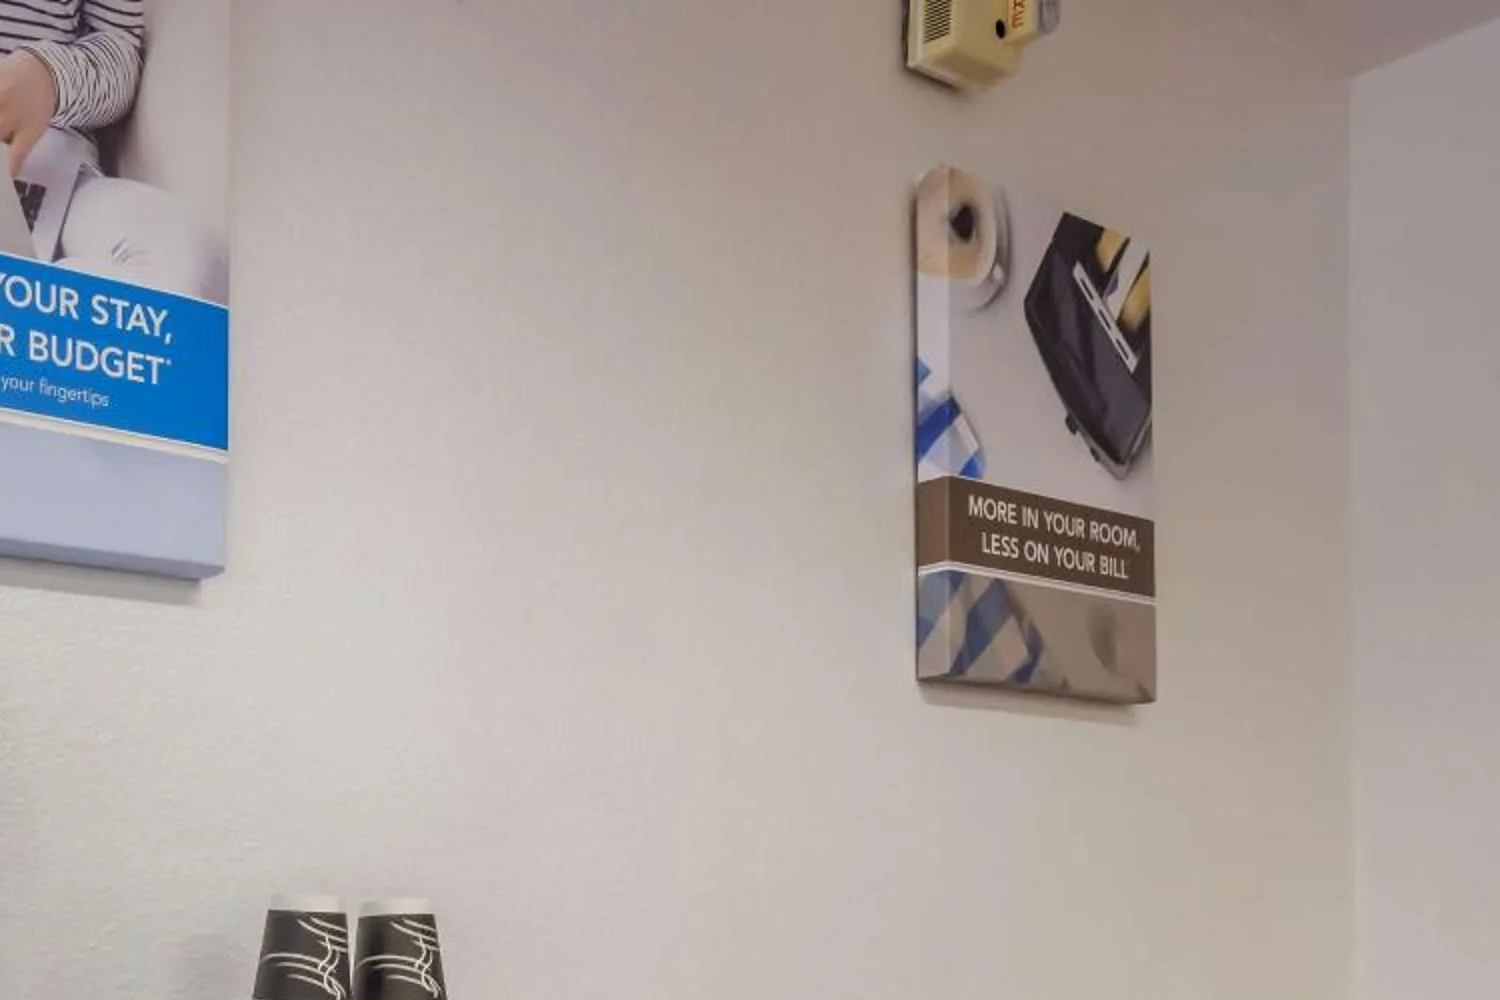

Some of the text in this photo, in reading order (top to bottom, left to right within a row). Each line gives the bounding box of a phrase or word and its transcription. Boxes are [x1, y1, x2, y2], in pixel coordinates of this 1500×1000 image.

[91, 293, 173, 345] STAY,
[1, 375, 35, 393] your
[39, 377, 110, 409] fingertips
[967, 495, 1141, 552] MORE IN YOUR ROOM,
[981, 532, 1129, 580] LESS ON YOUR BILL
